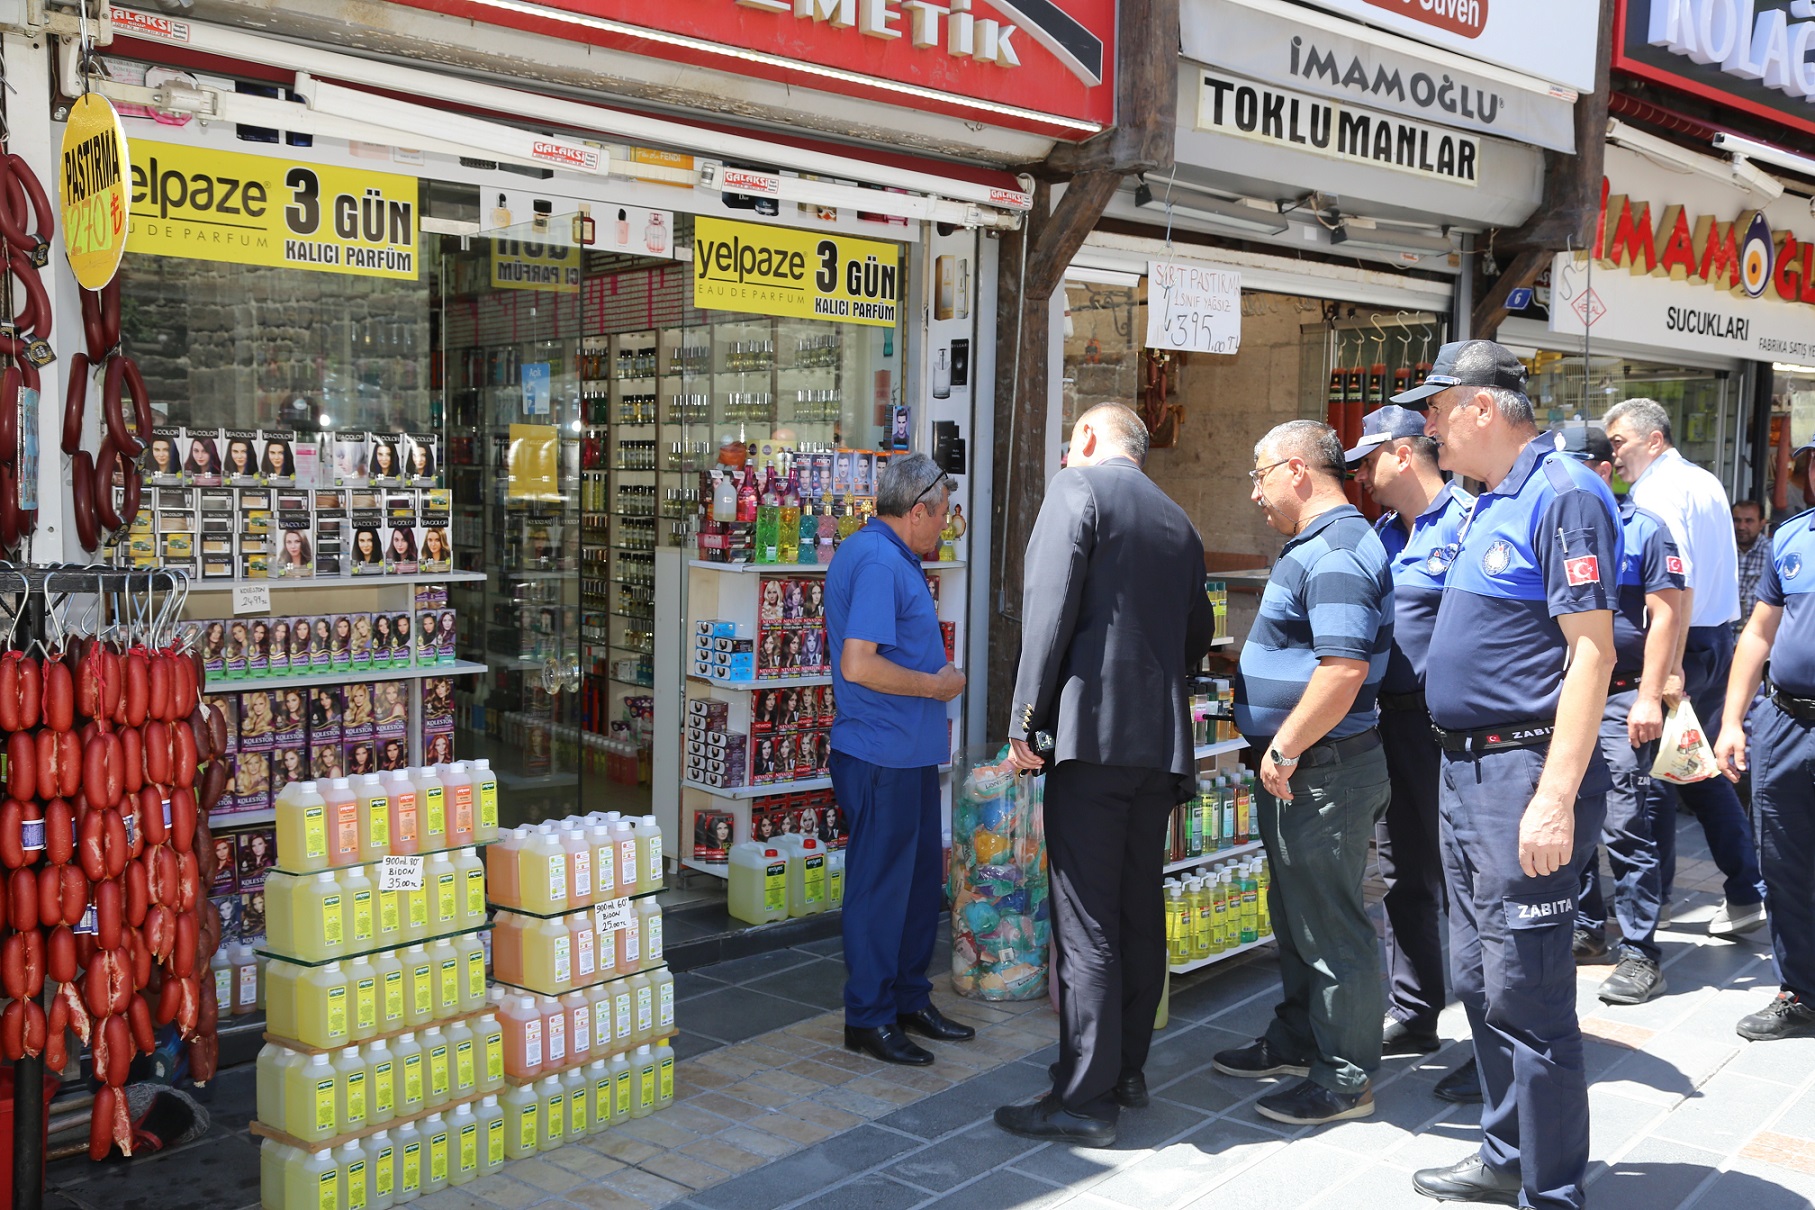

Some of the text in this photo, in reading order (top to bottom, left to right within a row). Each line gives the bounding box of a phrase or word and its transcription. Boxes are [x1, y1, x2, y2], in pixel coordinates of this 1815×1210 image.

[1290, 36, 1498, 124] İMAMOĞLU
[1204, 77, 1476, 181] TOKLUMANLAR
[64, 127, 121, 206] PASTIRMA
[70, 194, 106, 256] 270
[285, 167, 412, 246] 3 GÜN
[185, 229, 269, 248] PARFUM
[286, 240, 412, 272] KALICI PARFÜM
[697, 236, 805, 283] yelpaze
[816, 240, 895, 299] 3 GÜN
[699, 284, 805, 304] EAU DE PARFUM
[815, 297, 894, 321] KALICI PARFÜM
[1514, 292, 1522, 305] 6
[1666, 306, 1750, 341] SUCUKLARI
[1517, 898, 1573, 919] ZABITA
